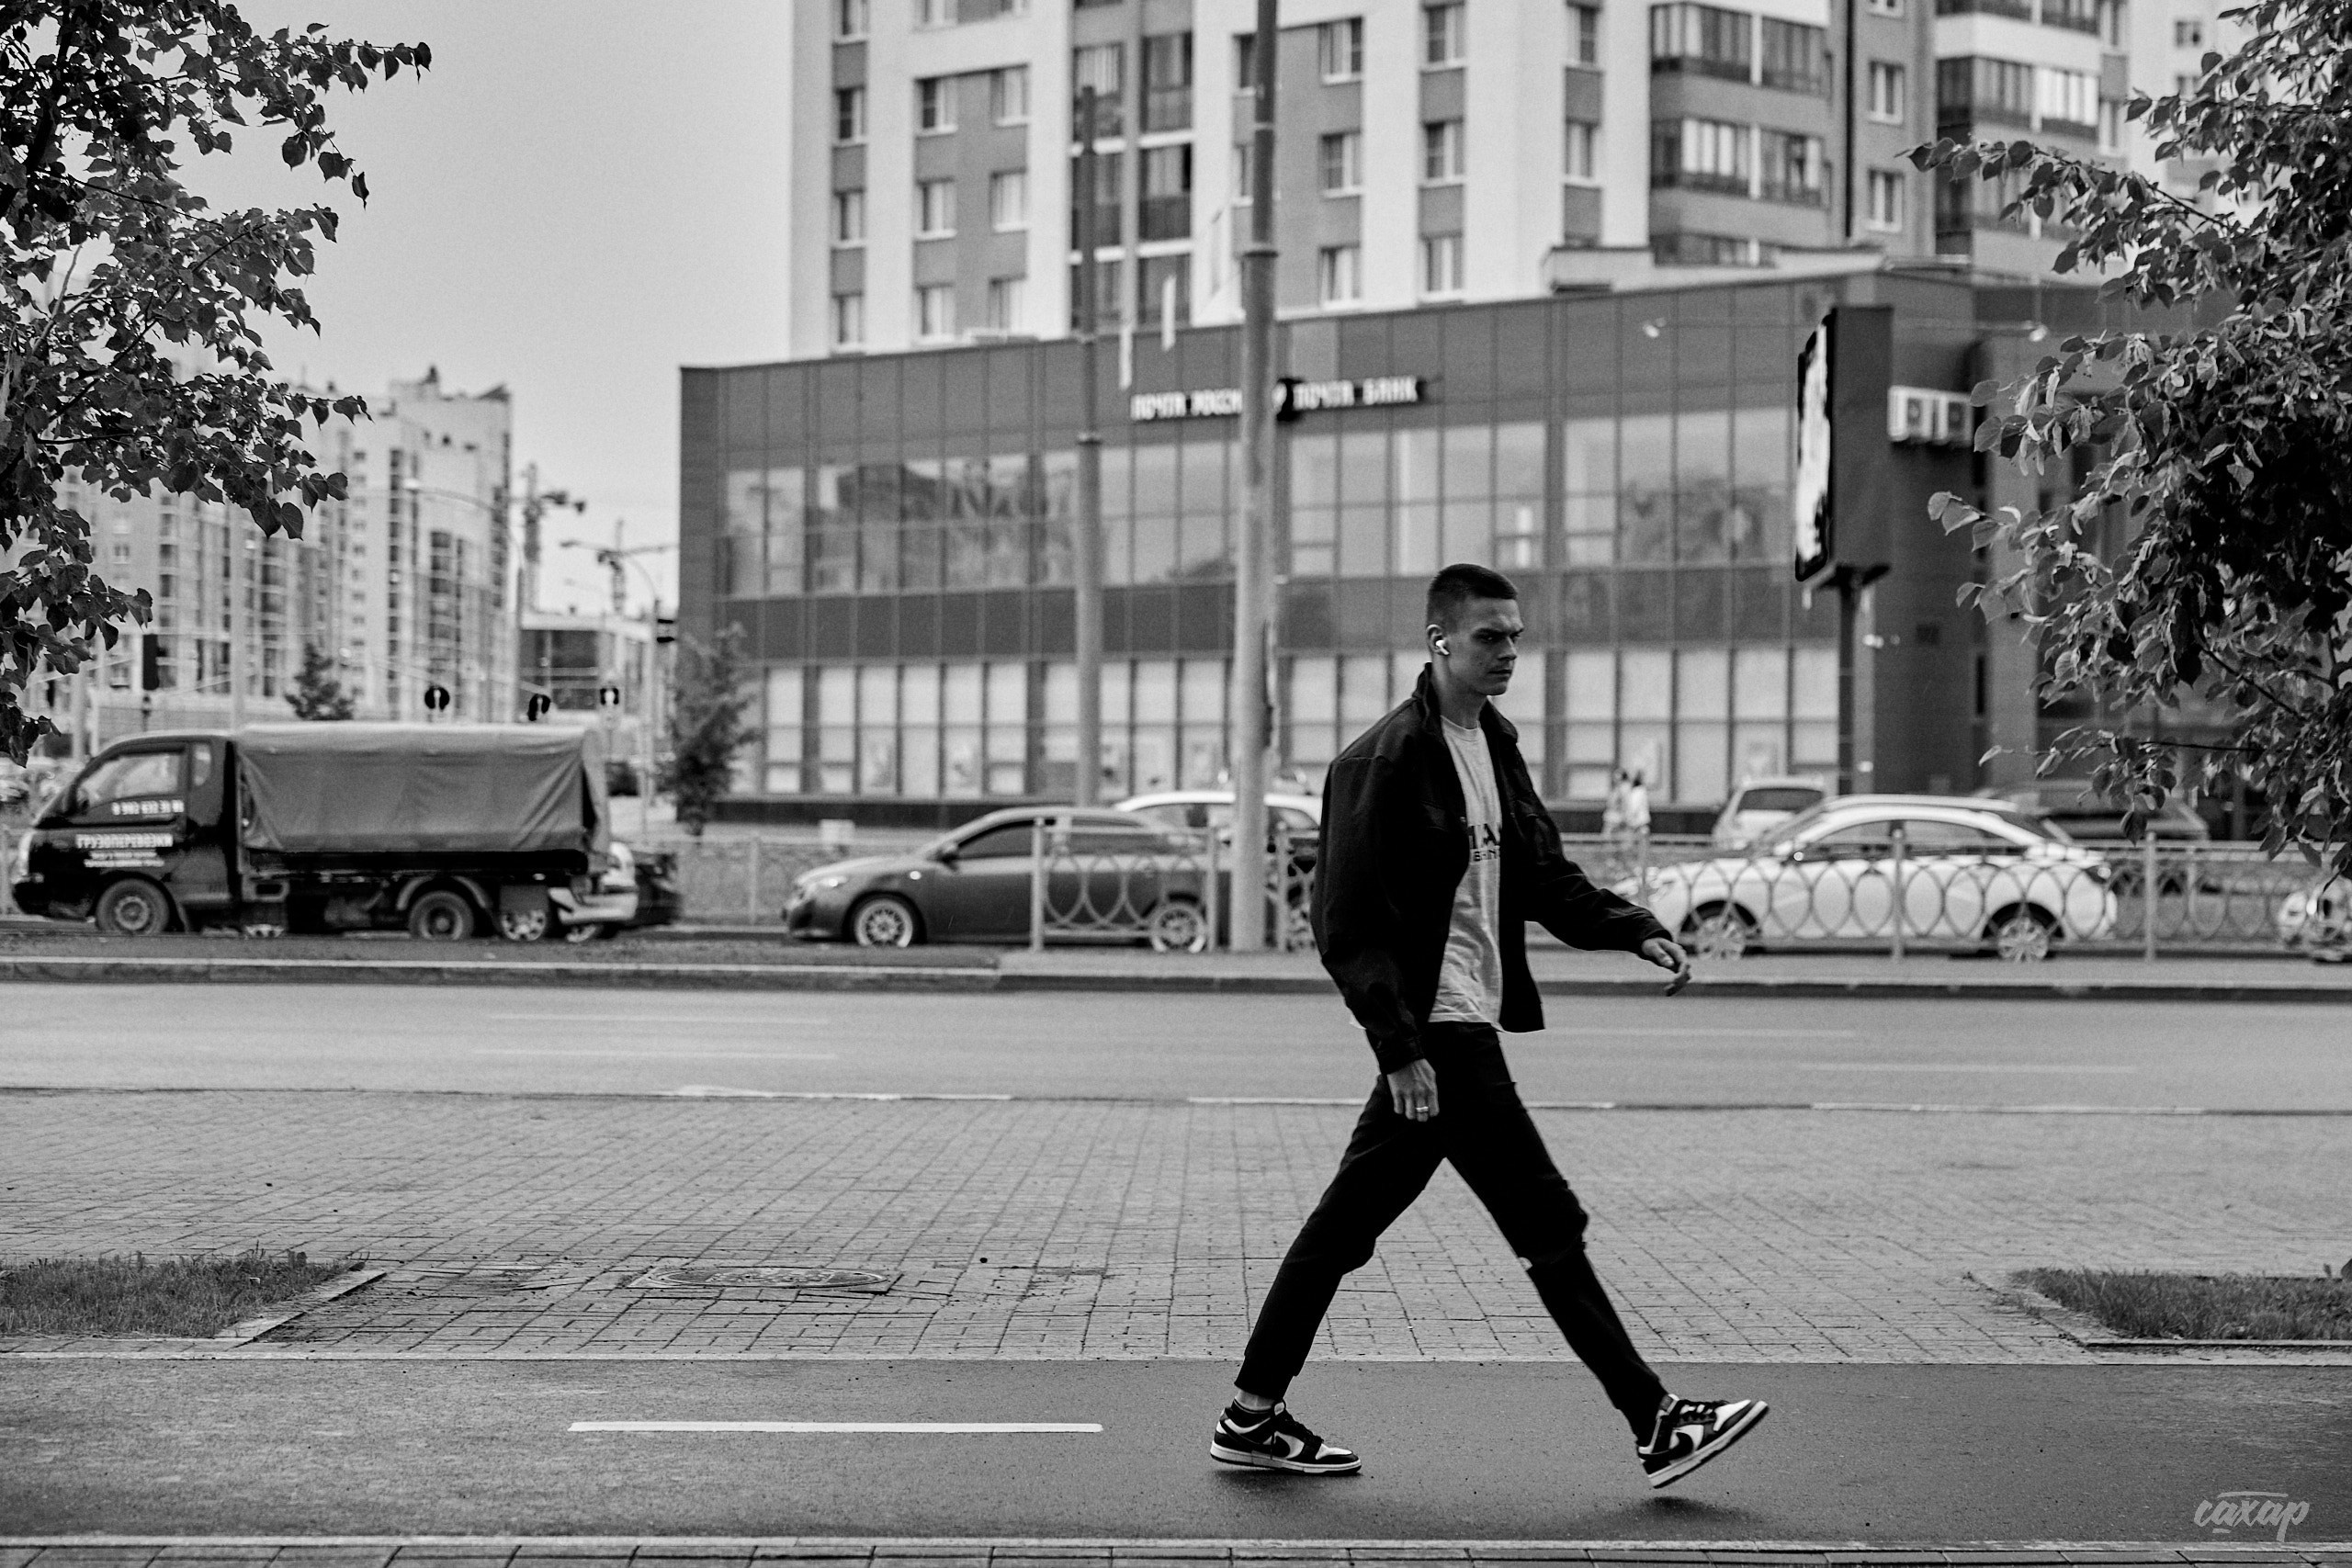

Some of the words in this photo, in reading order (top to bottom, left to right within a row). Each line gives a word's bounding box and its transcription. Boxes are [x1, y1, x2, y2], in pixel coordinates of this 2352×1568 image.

[1130, 391, 1187, 420] ПОЧТА
[1191, 388, 1243, 415] РОССИ
[1294, 379, 1355, 411] ПОЧТА
[1362, 376, 1419, 405] БАНК
[75, 833, 174, 848] ГРУЗОПЕРЕВОЗКИ
